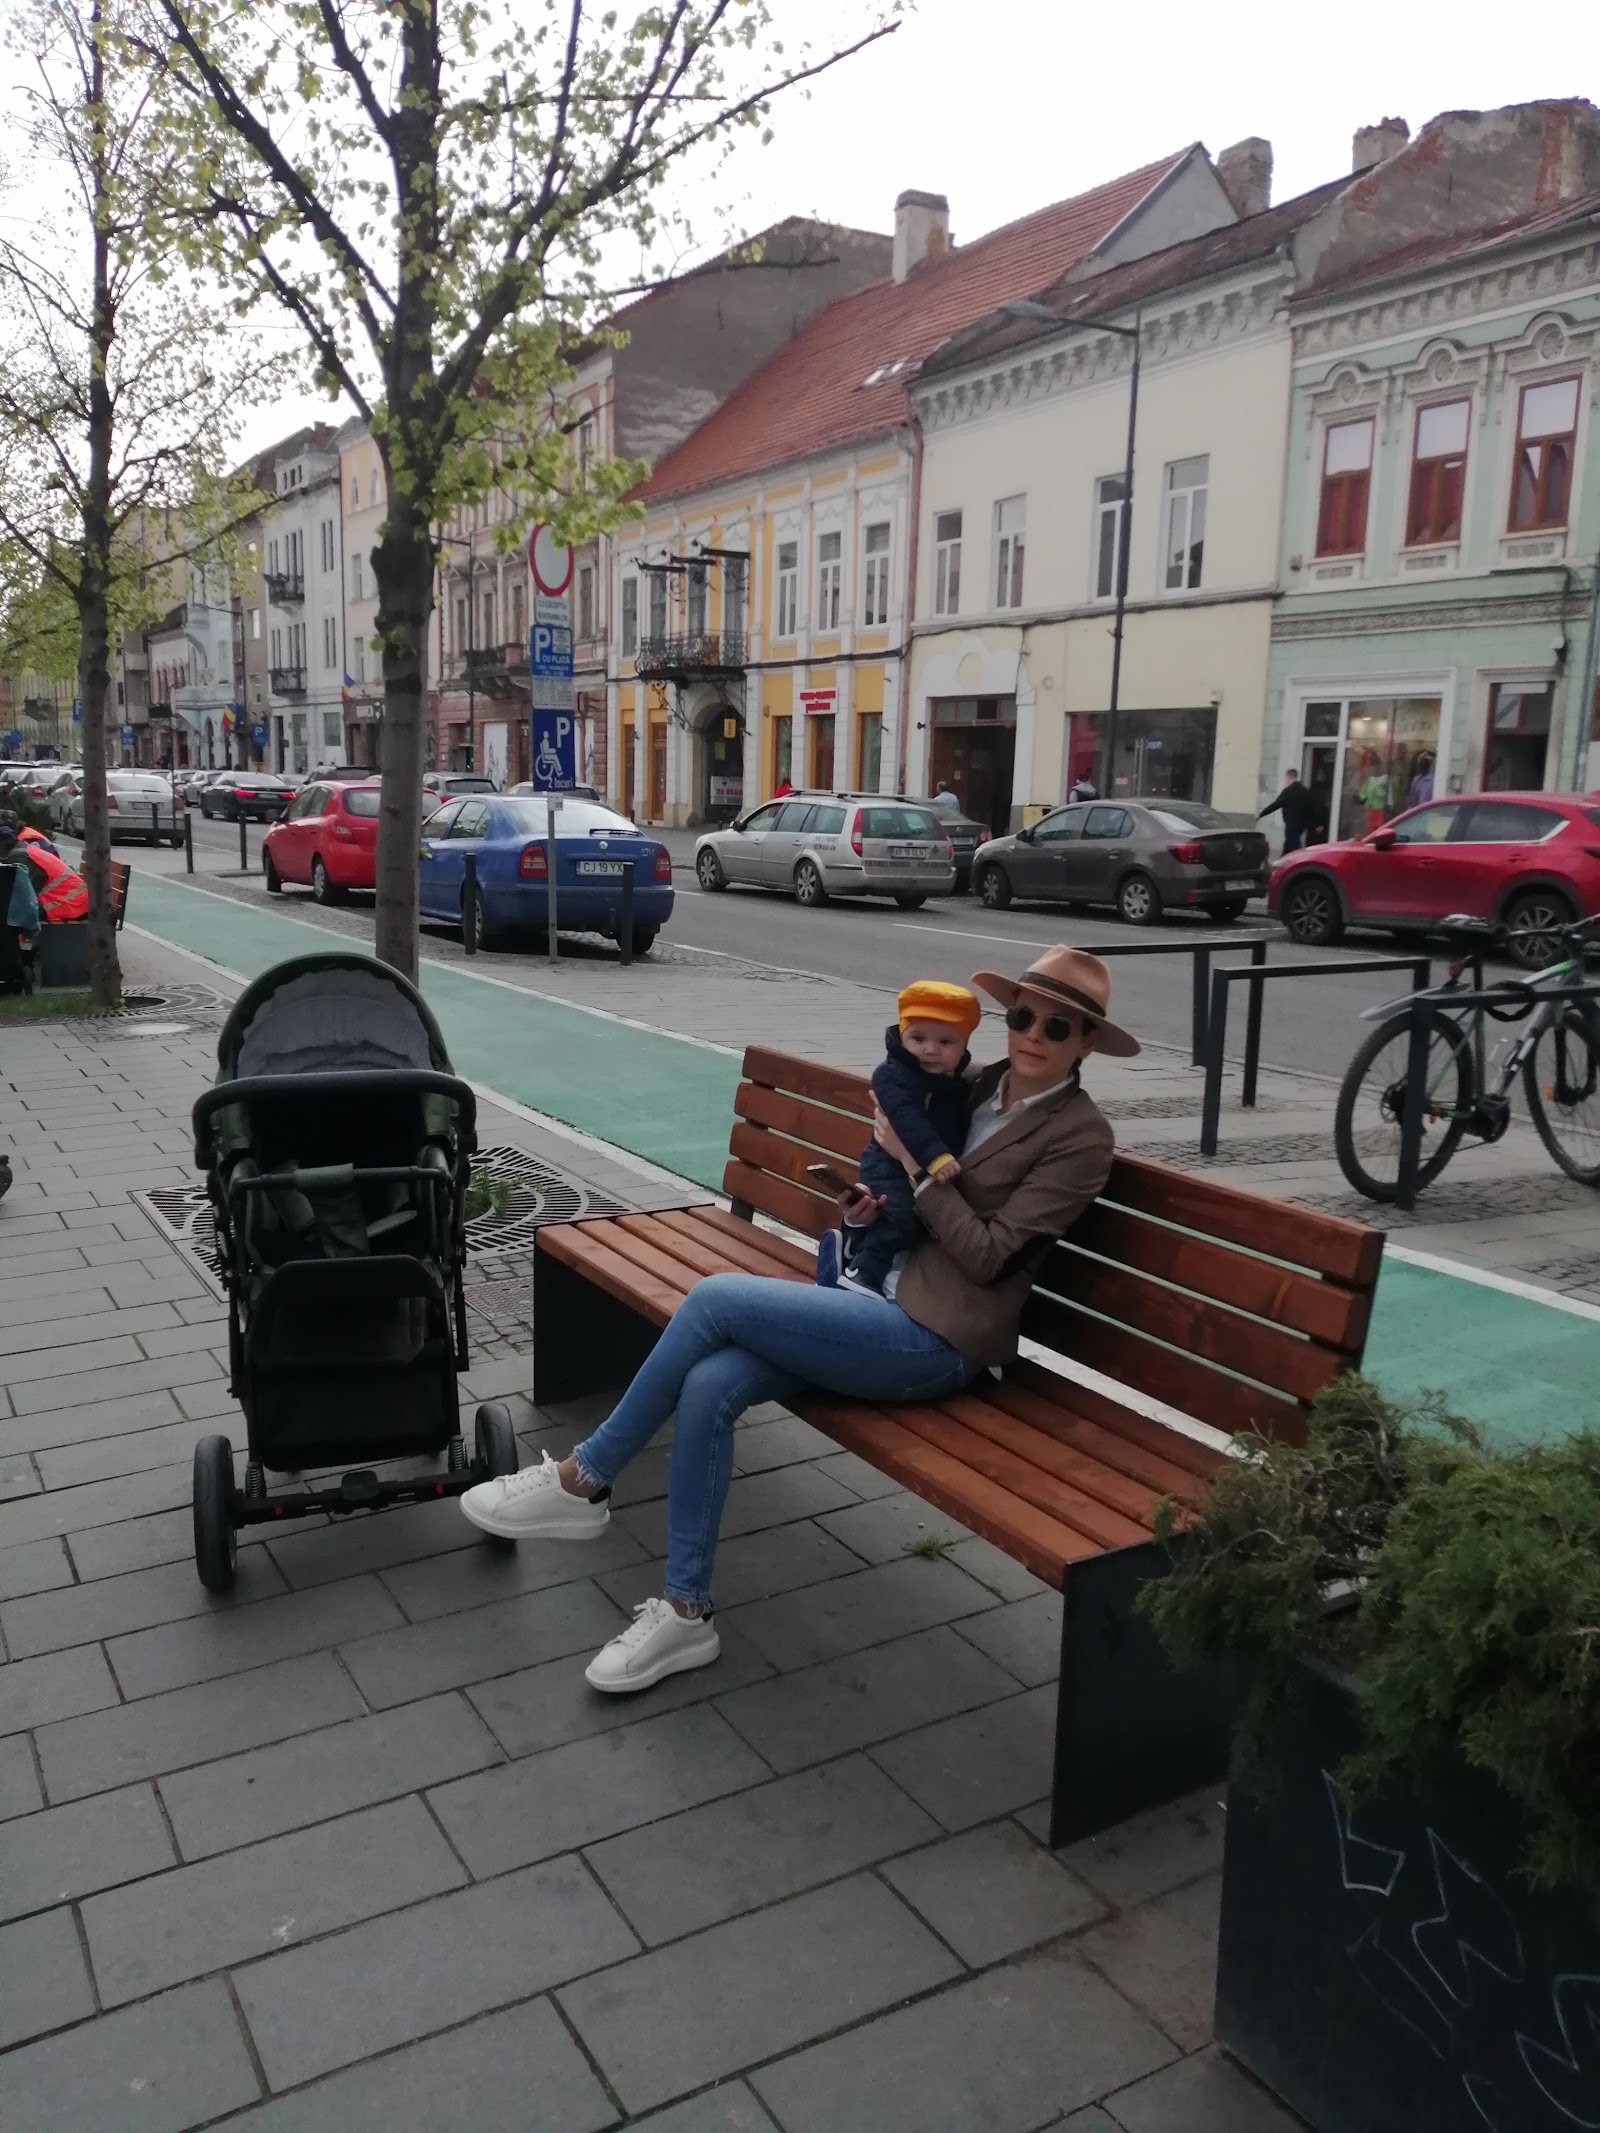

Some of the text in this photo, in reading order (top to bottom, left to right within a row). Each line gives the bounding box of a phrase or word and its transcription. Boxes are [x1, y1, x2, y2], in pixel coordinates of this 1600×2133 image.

[535, 627, 551, 663] P
[557, 717, 570, 748] P
[583, 862, 623, 873] CJ 19 YX
